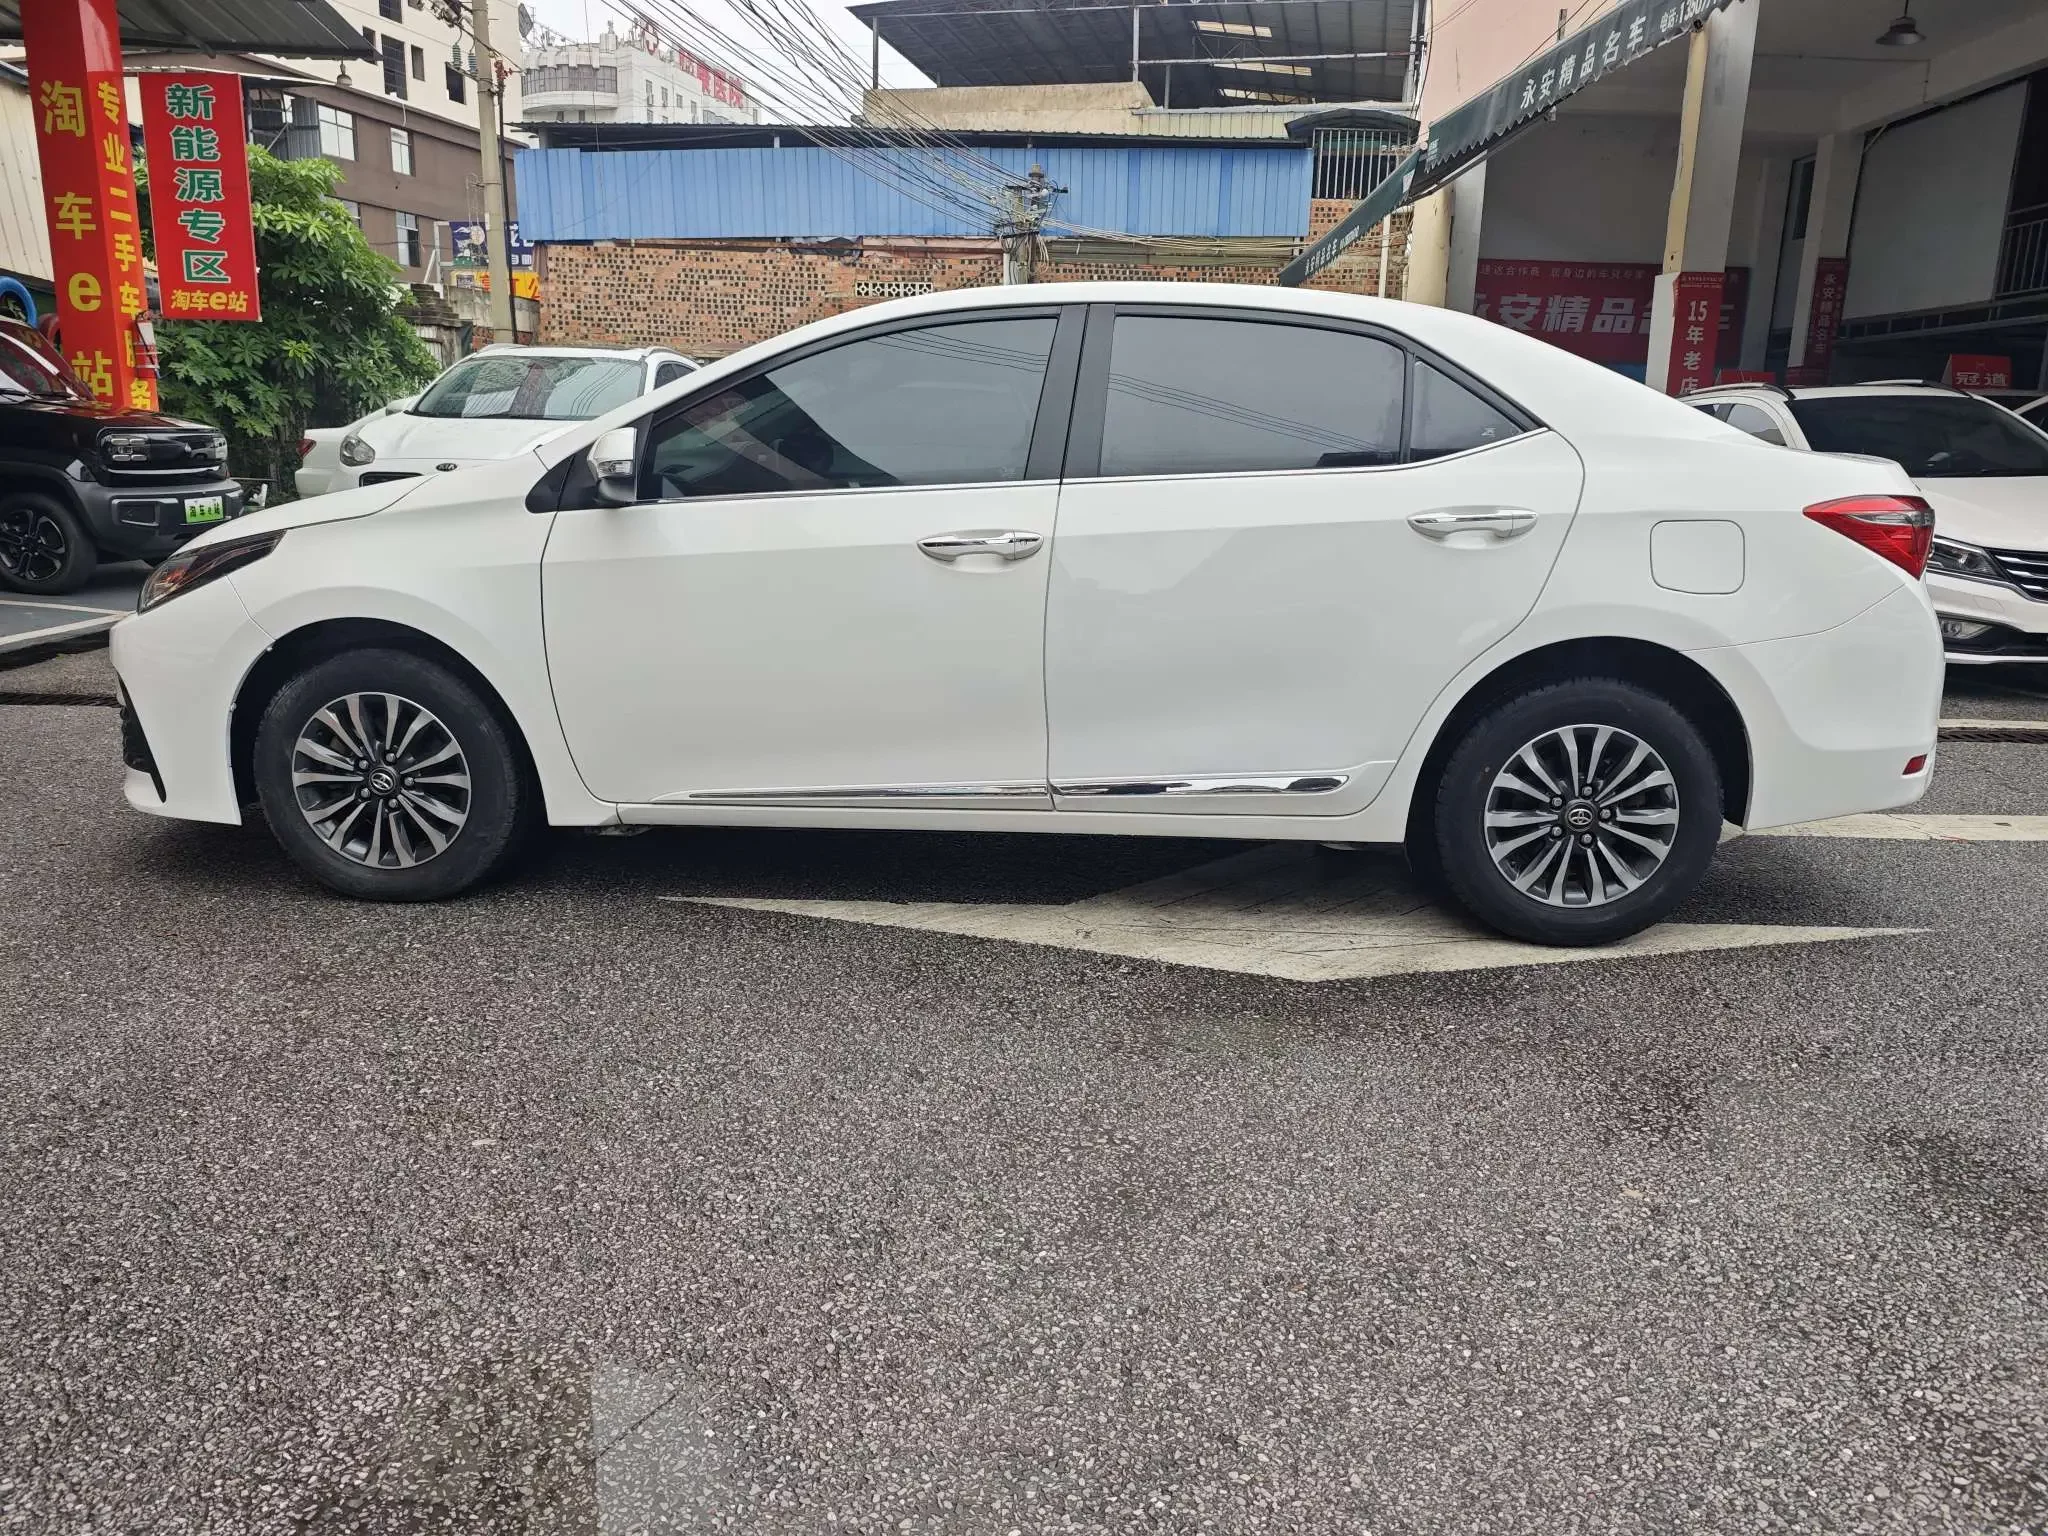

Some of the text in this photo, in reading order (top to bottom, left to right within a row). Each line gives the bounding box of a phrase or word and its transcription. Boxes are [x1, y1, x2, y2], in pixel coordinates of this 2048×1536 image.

[1520, 15, 1647, 109] 永安精品名车
[165, 82, 231, 283] 新能源专区
[40, 80, 114, 397] 淘车e站
[171, 289, 248, 312] 淘车e站
[1680, 300, 1708, 394] 15年老店
[1956, 372, 2008, 387] 冠道
